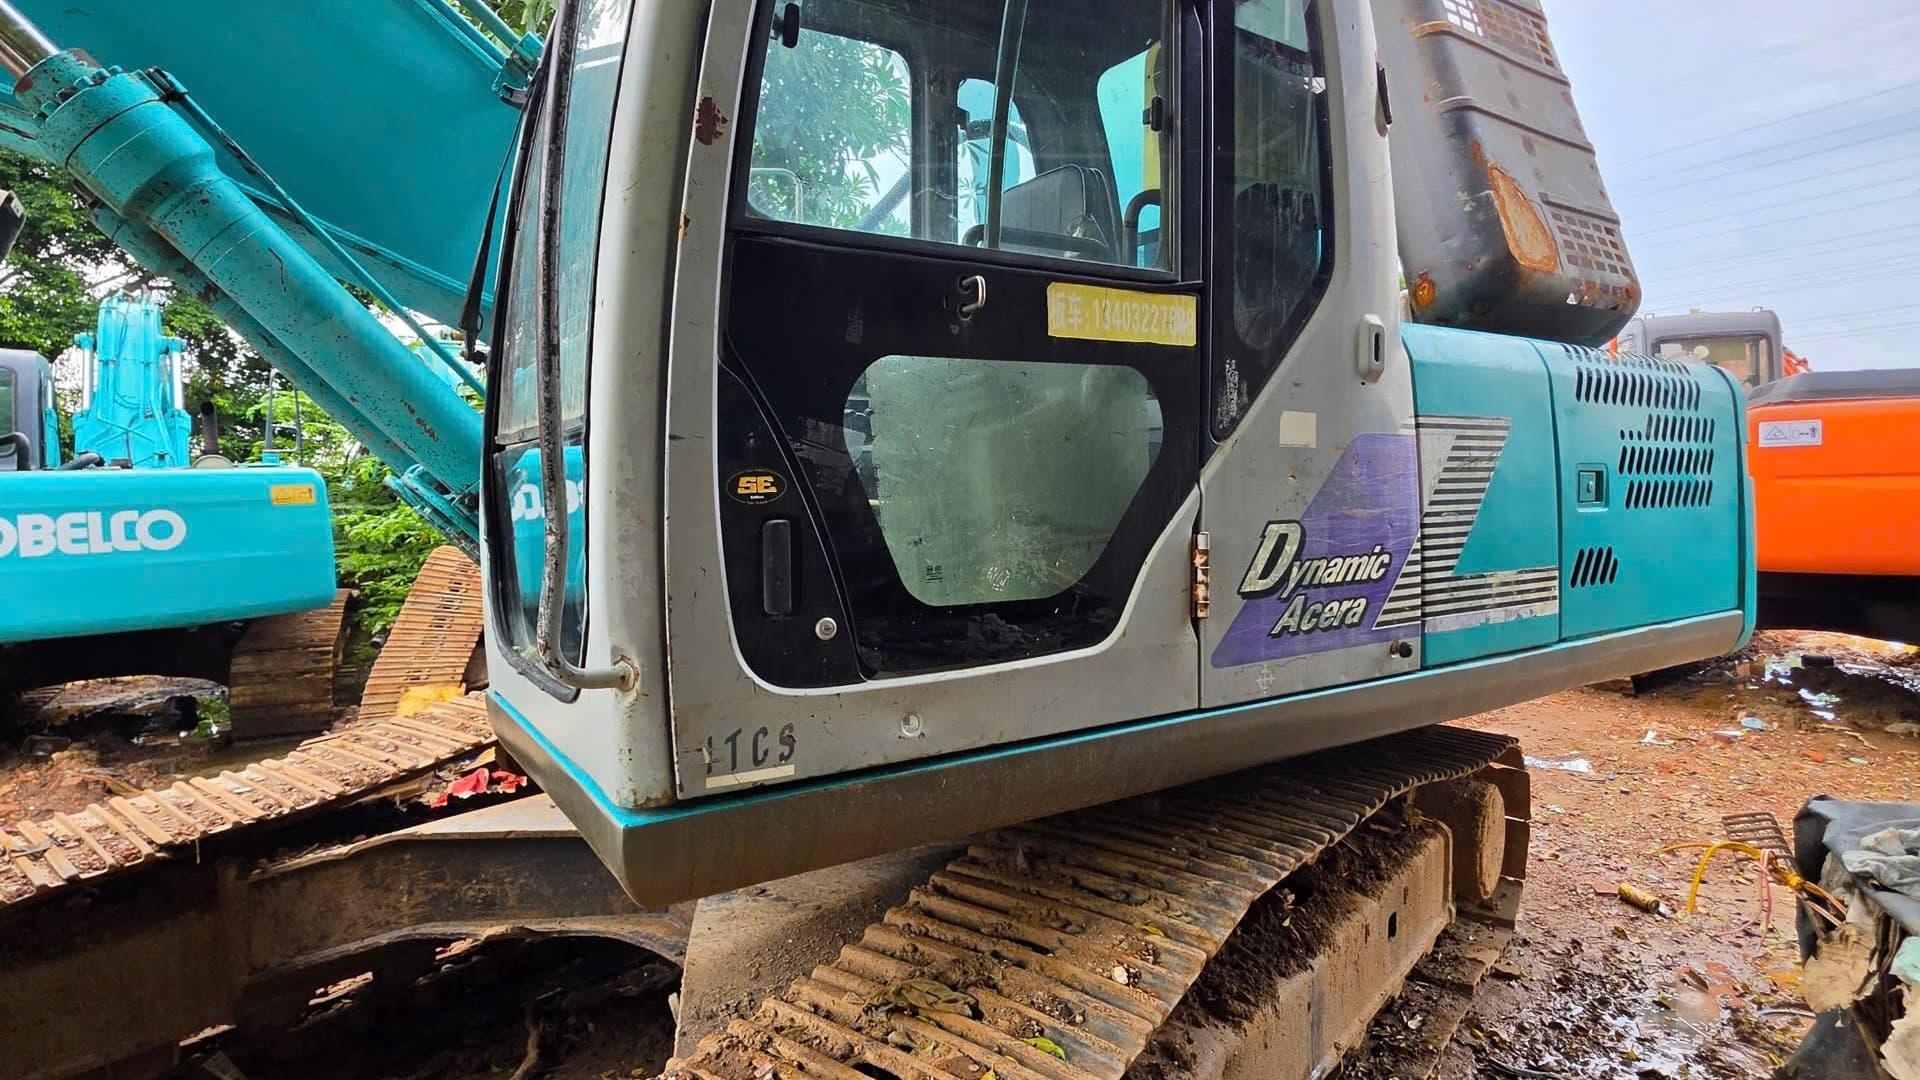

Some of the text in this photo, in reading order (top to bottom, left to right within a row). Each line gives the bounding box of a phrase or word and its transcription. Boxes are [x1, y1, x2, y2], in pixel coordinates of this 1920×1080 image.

[737, 476, 778, 494] SE
[1238, 519, 1392, 600] Dynamic
[1269, 594, 1368, 637] Acera
